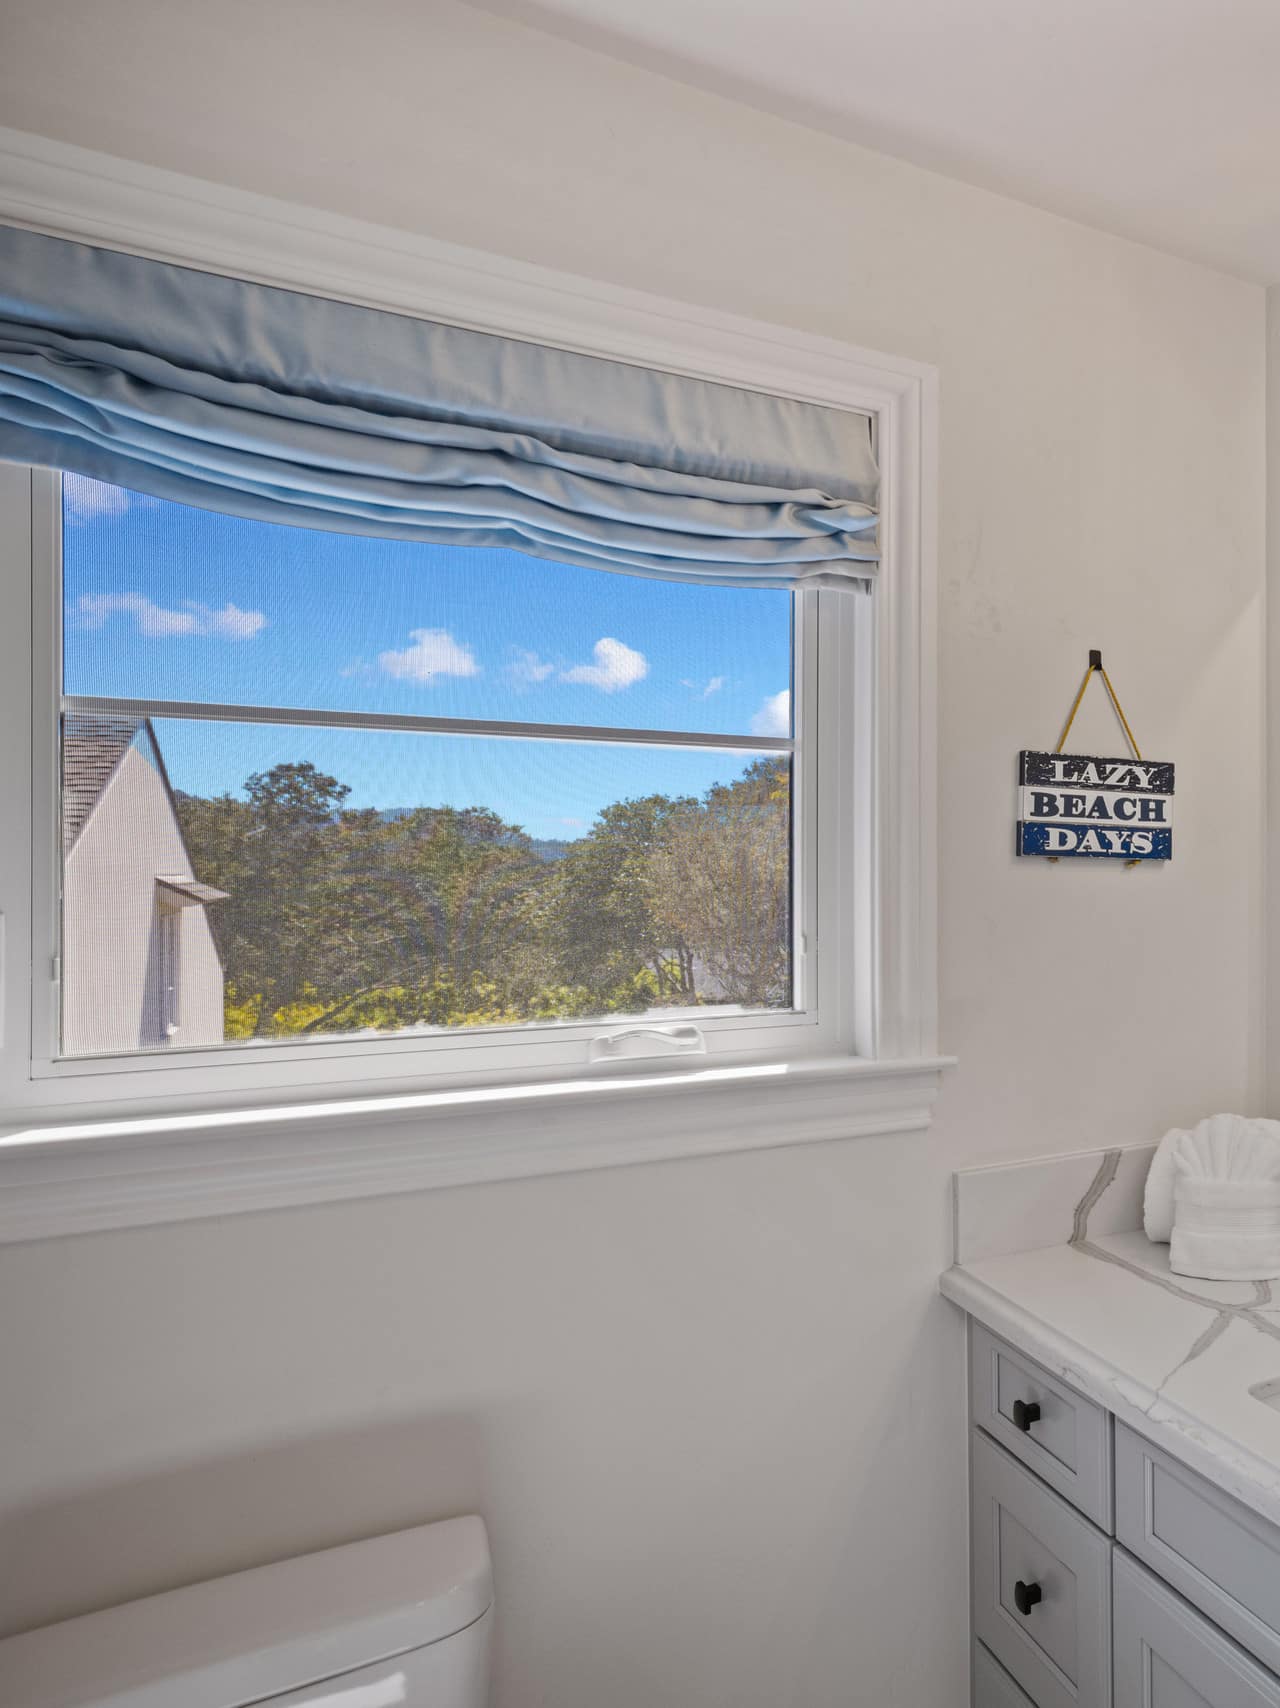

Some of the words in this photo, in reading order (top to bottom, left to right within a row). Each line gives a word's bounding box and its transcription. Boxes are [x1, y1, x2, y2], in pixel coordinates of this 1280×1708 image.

[1050, 760, 1157, 789] LAZY
[1030, 792, 1166, 822] BEACH
[1044, 827, 1153, 854] DAYS
